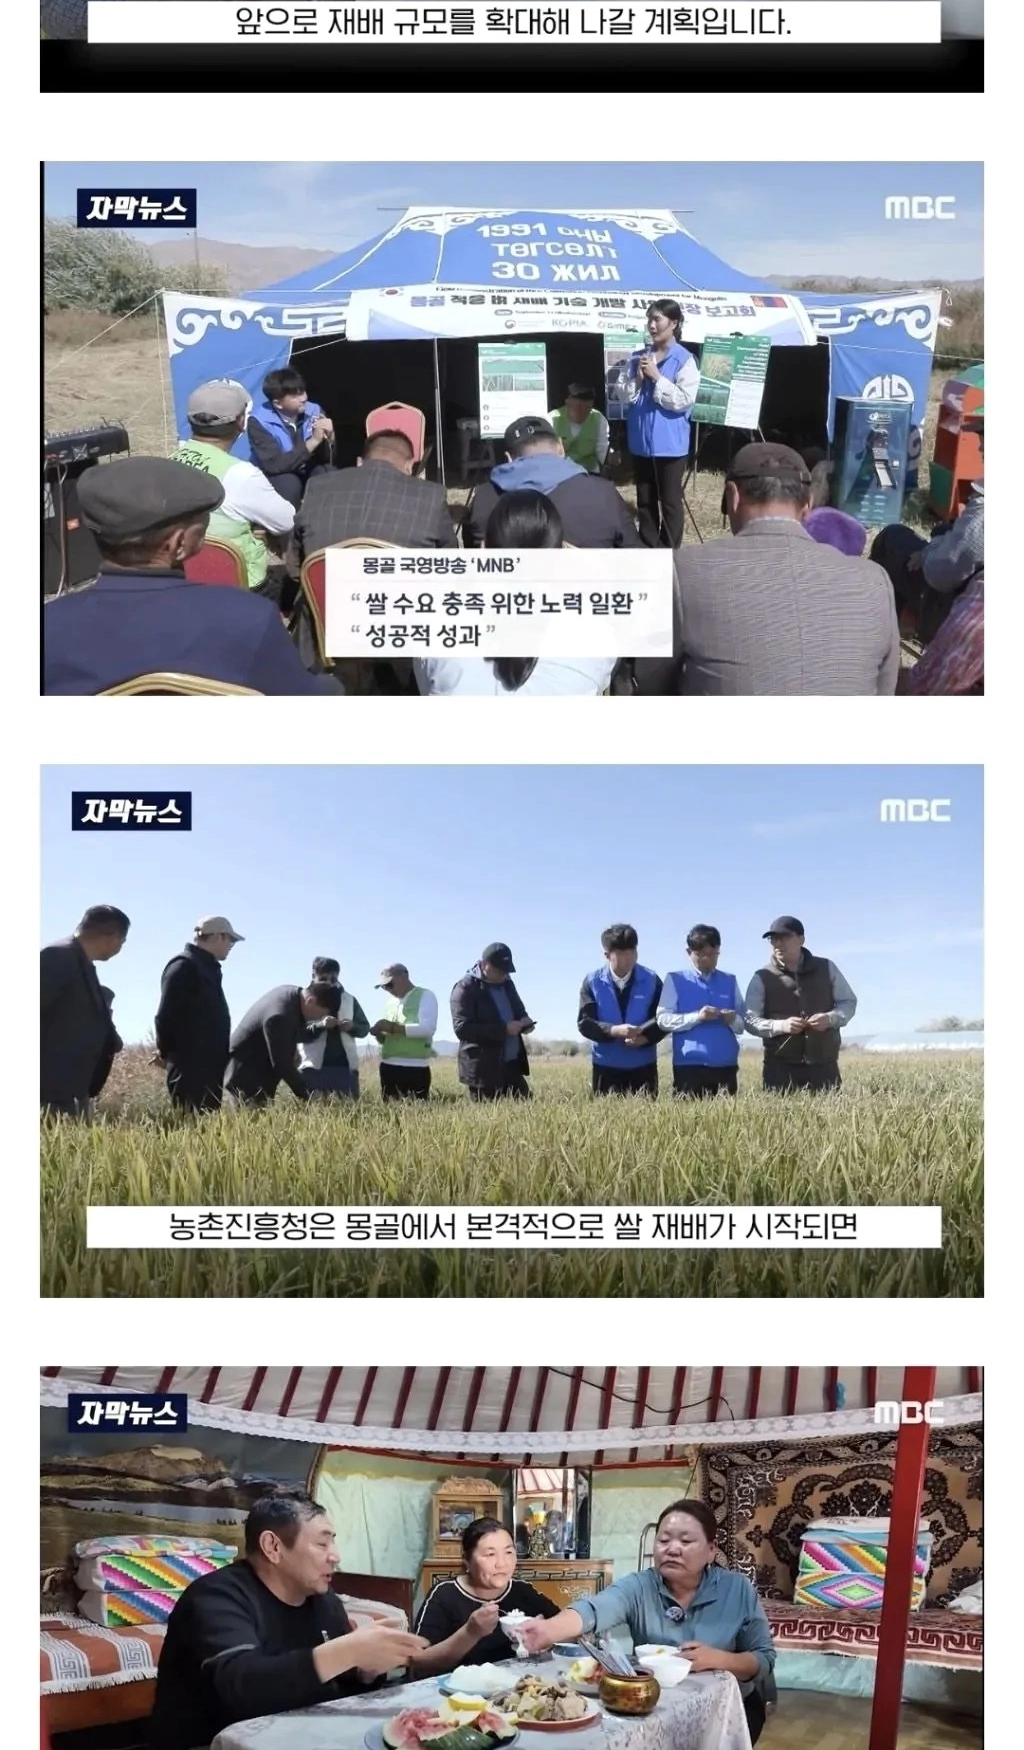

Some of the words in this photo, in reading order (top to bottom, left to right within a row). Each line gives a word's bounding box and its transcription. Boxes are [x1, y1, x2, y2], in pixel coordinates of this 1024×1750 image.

[476, 222, 548, 239] 1991
[491, 261, 541, 280] 30
[552, 262, 622, 282] ЖИЛ
[552, 297, 588, 307] 기술
[592, 297, 627, 309] 개발
[705, 305, 757, 318] 보고회
